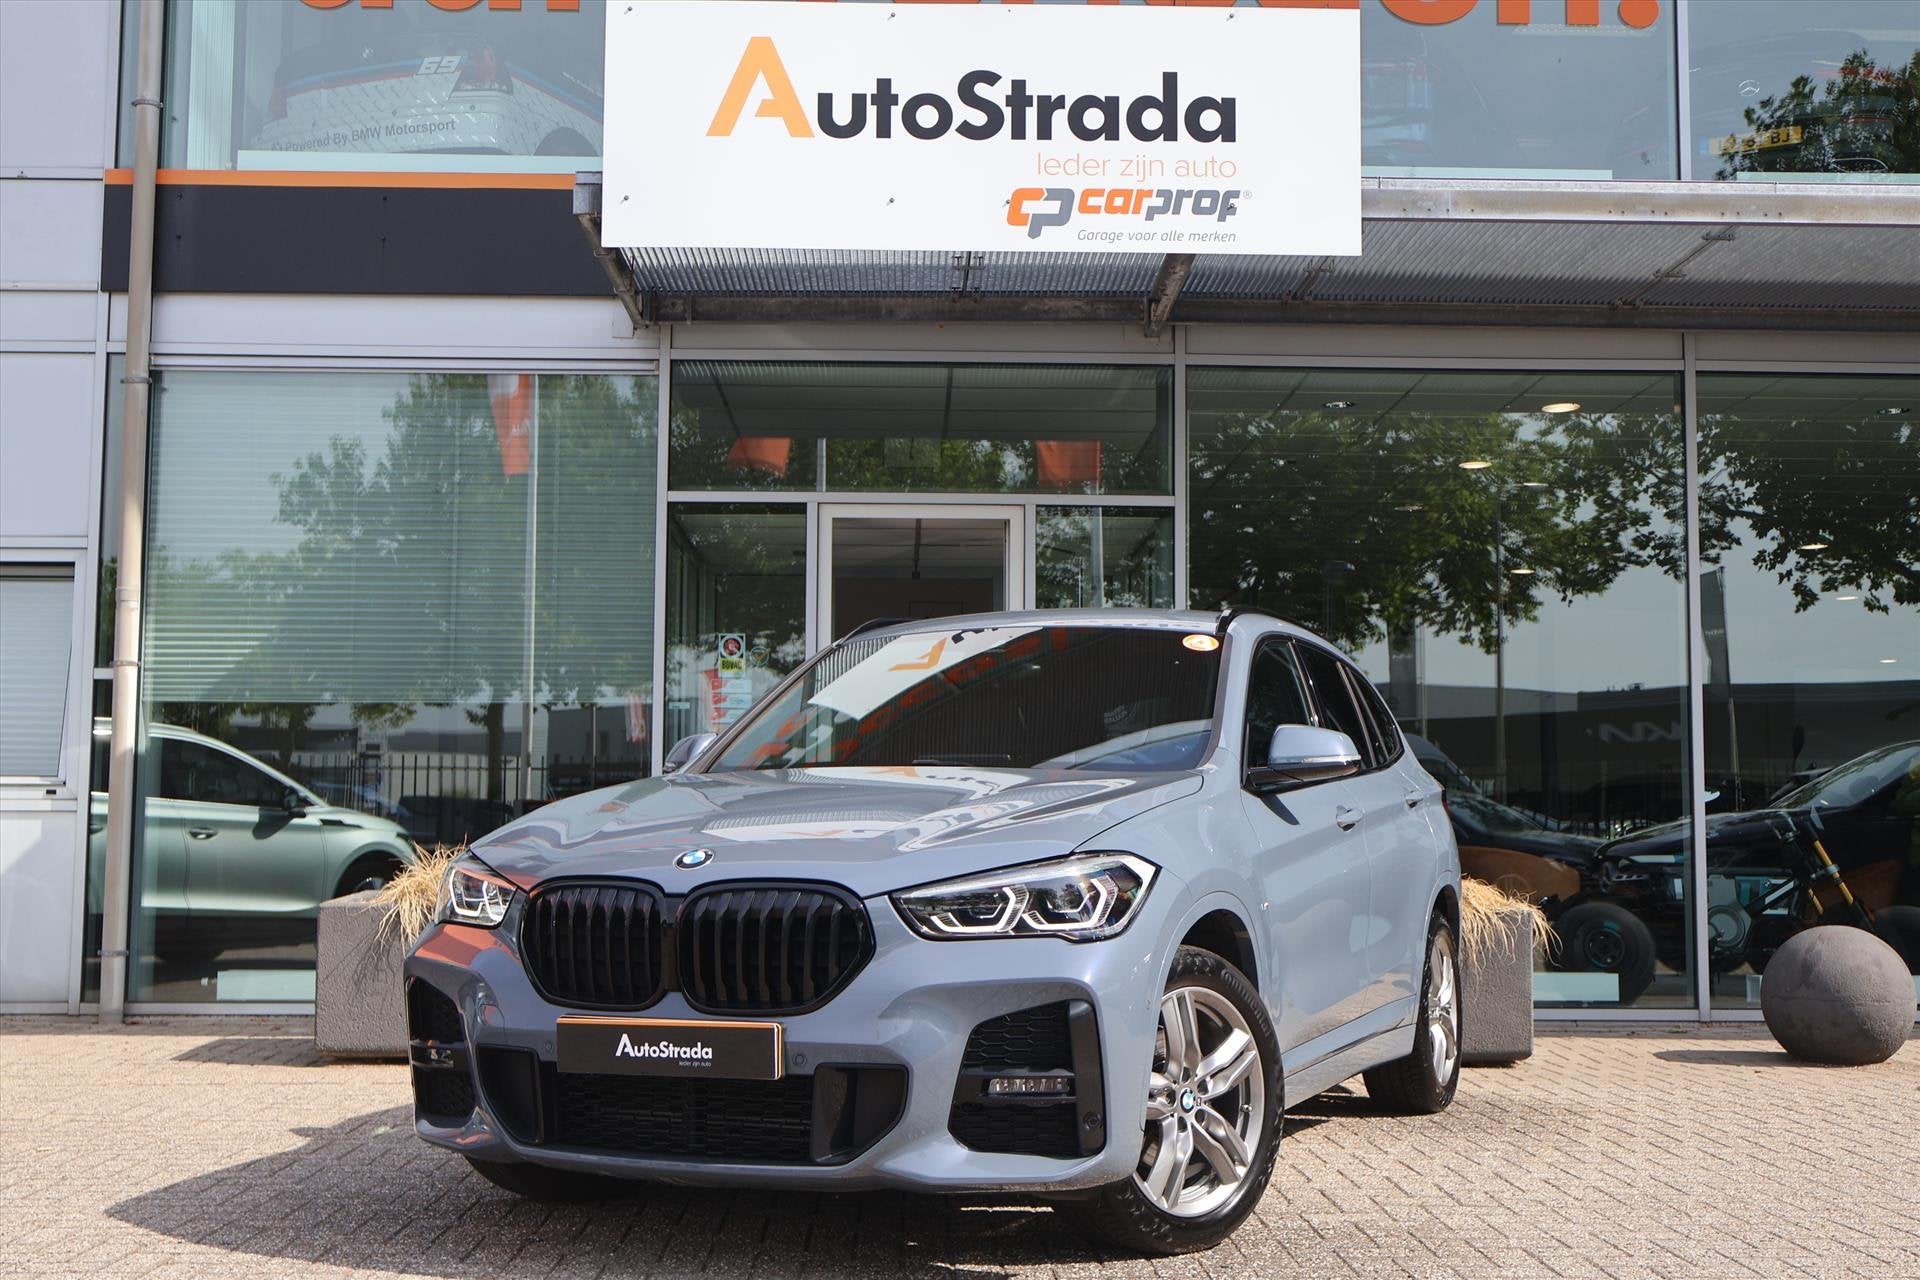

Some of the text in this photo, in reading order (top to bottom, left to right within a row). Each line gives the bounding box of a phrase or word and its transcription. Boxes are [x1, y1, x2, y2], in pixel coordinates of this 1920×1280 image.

[416, 56, 463, 76] 69
[706, 37, 1236, 143] AutoStrada
[333, 132, 348, 146] By
[352, 126, 381, 142] BMW
[385, 119, 456, 138] Motorsport
[1037, 152, 1238, 183] Ieder zijn auto
[1077, 229, 1237, 243] Garage voor alle merken
[616, 1034, 712, 1059] AutoStrada
